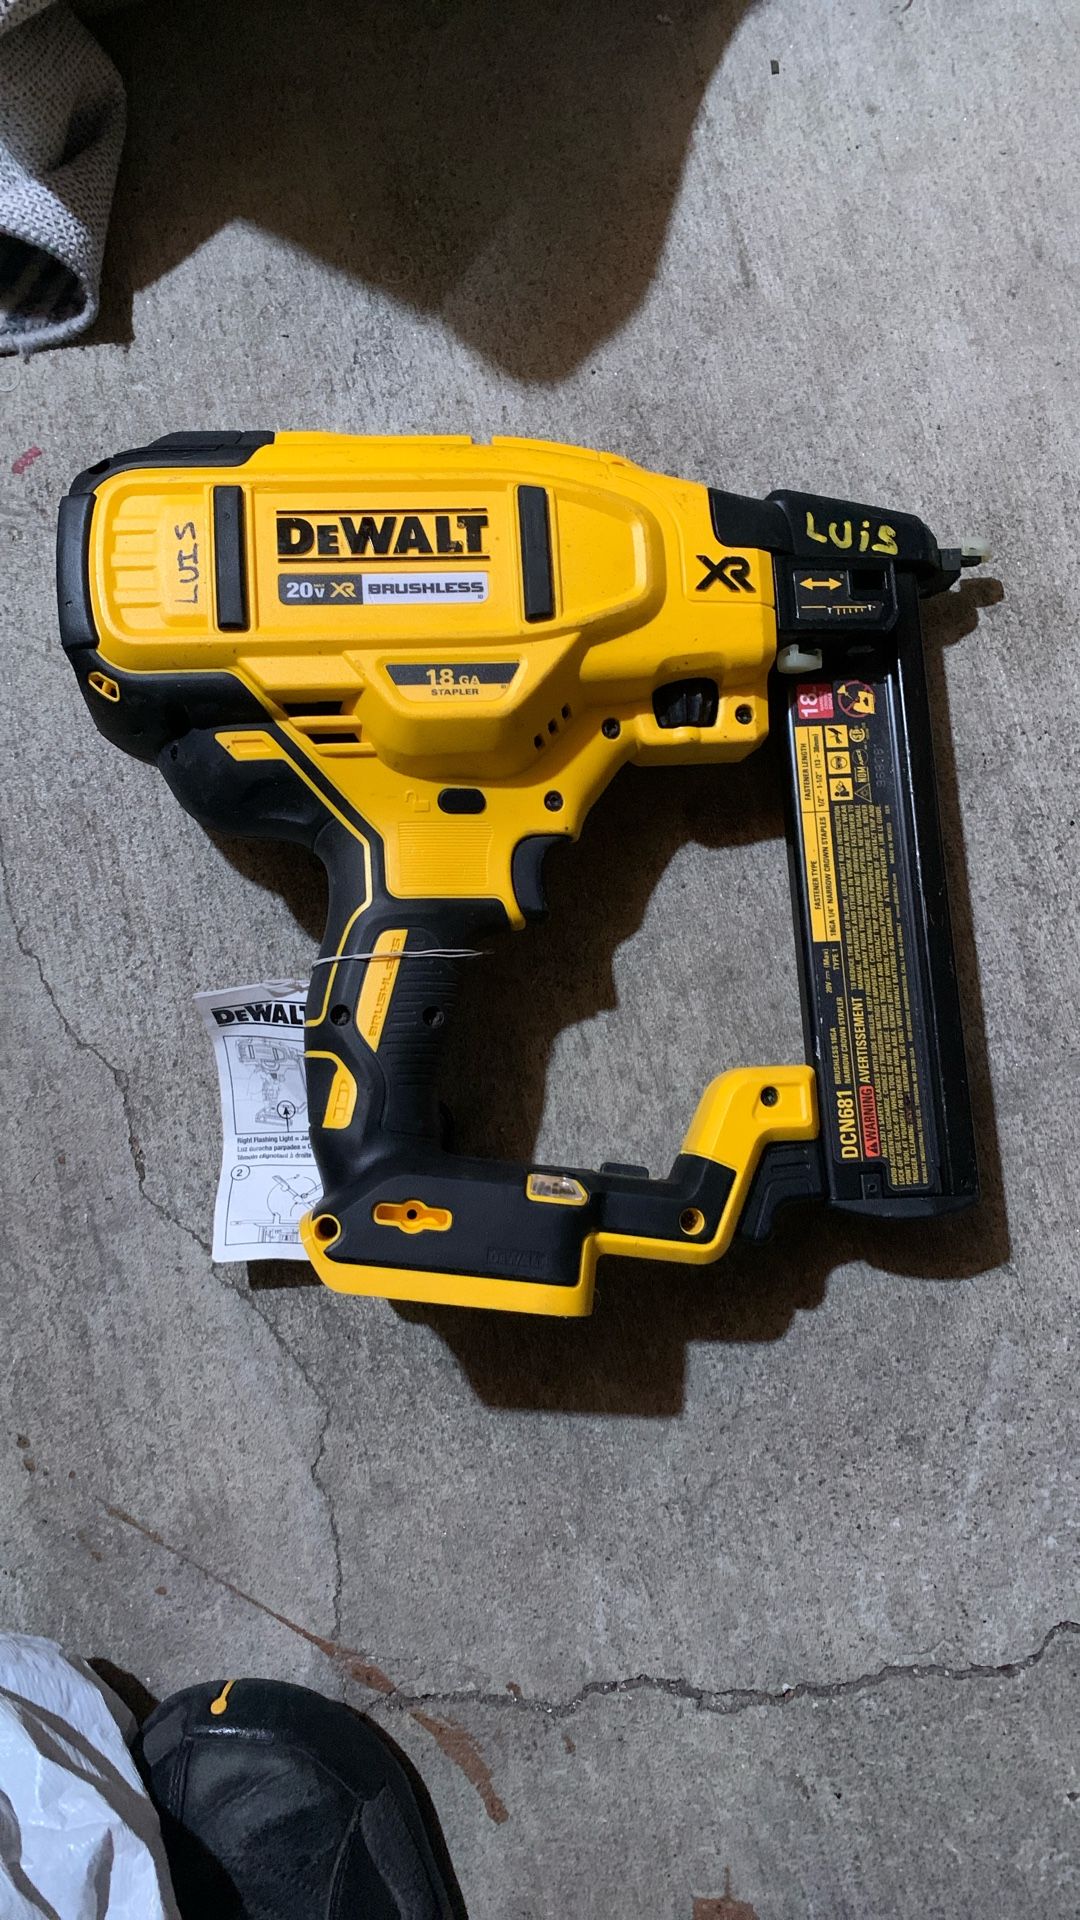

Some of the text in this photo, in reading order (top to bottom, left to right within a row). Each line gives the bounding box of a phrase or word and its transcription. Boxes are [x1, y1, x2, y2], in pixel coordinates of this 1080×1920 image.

[174, 523, 198, 604] LUIS
[695, 555, 757, 592] XR
[330, 582, 357, 598] XR
[368, 581, 485, 595] BRUSHLESS
[425, 668, 481, 688] 18 GA
[431, 688, 480, 696] STAPLER
[799, 692, 818, 717] 18
[800, 743, 811, 800] FASTENER LENGTH
[819, 816, 827, 844] STAPLES
[822, 846, 830, 871] CROWN
[810, 860, 821, 909] FASTENER TYPE
[824, 872, 833, 903] NARROW
[831, 953, 839, 970] TYPE
[835, 996, 845, 1025] STAPLER
[838, 1026, 847, 1052] CROWN
[851, 995, 870, 1082] AVERTISSEMENT
[836, 1090, 858, 1158] DCN681
[861, 1088, 876, 1141] WARNING
[236, 1169, 243, 1177] 2
